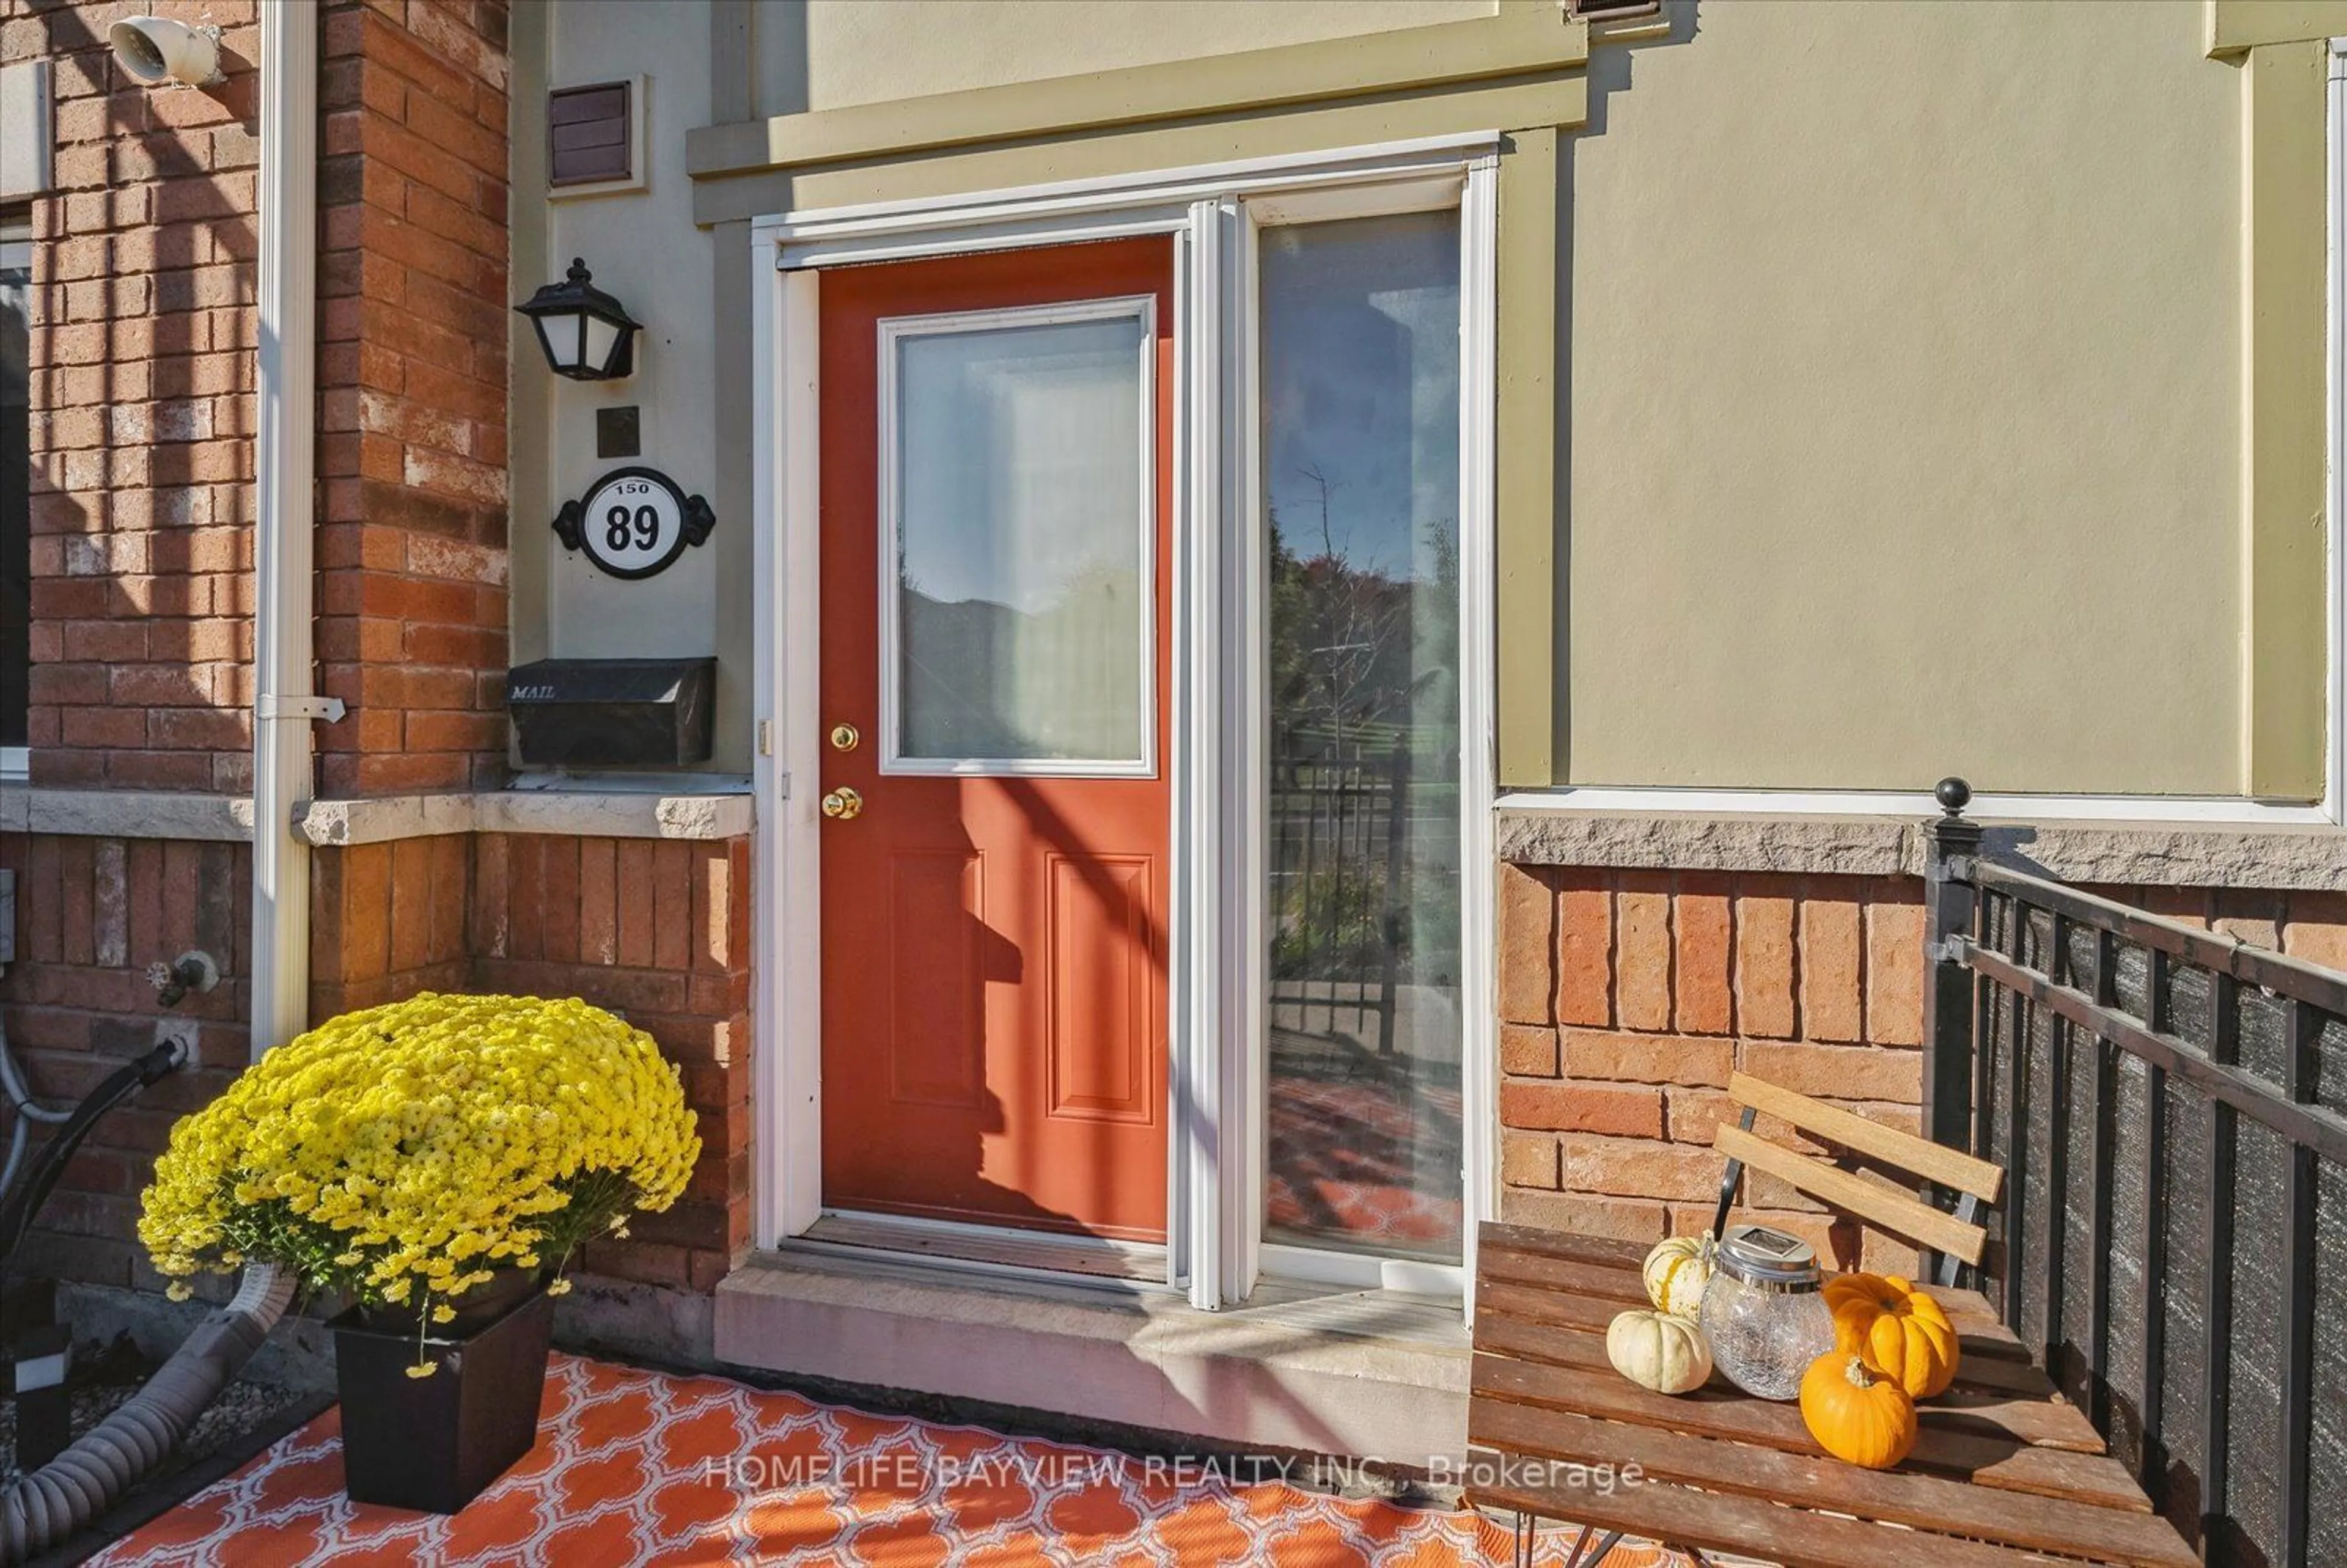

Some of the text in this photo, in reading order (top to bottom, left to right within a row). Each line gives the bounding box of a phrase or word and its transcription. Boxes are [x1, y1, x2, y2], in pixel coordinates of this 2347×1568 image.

[616, 483, 648, 494] 150
[606, 505, 659, 551] 89
[512, 686, 555, 699] MAIL
